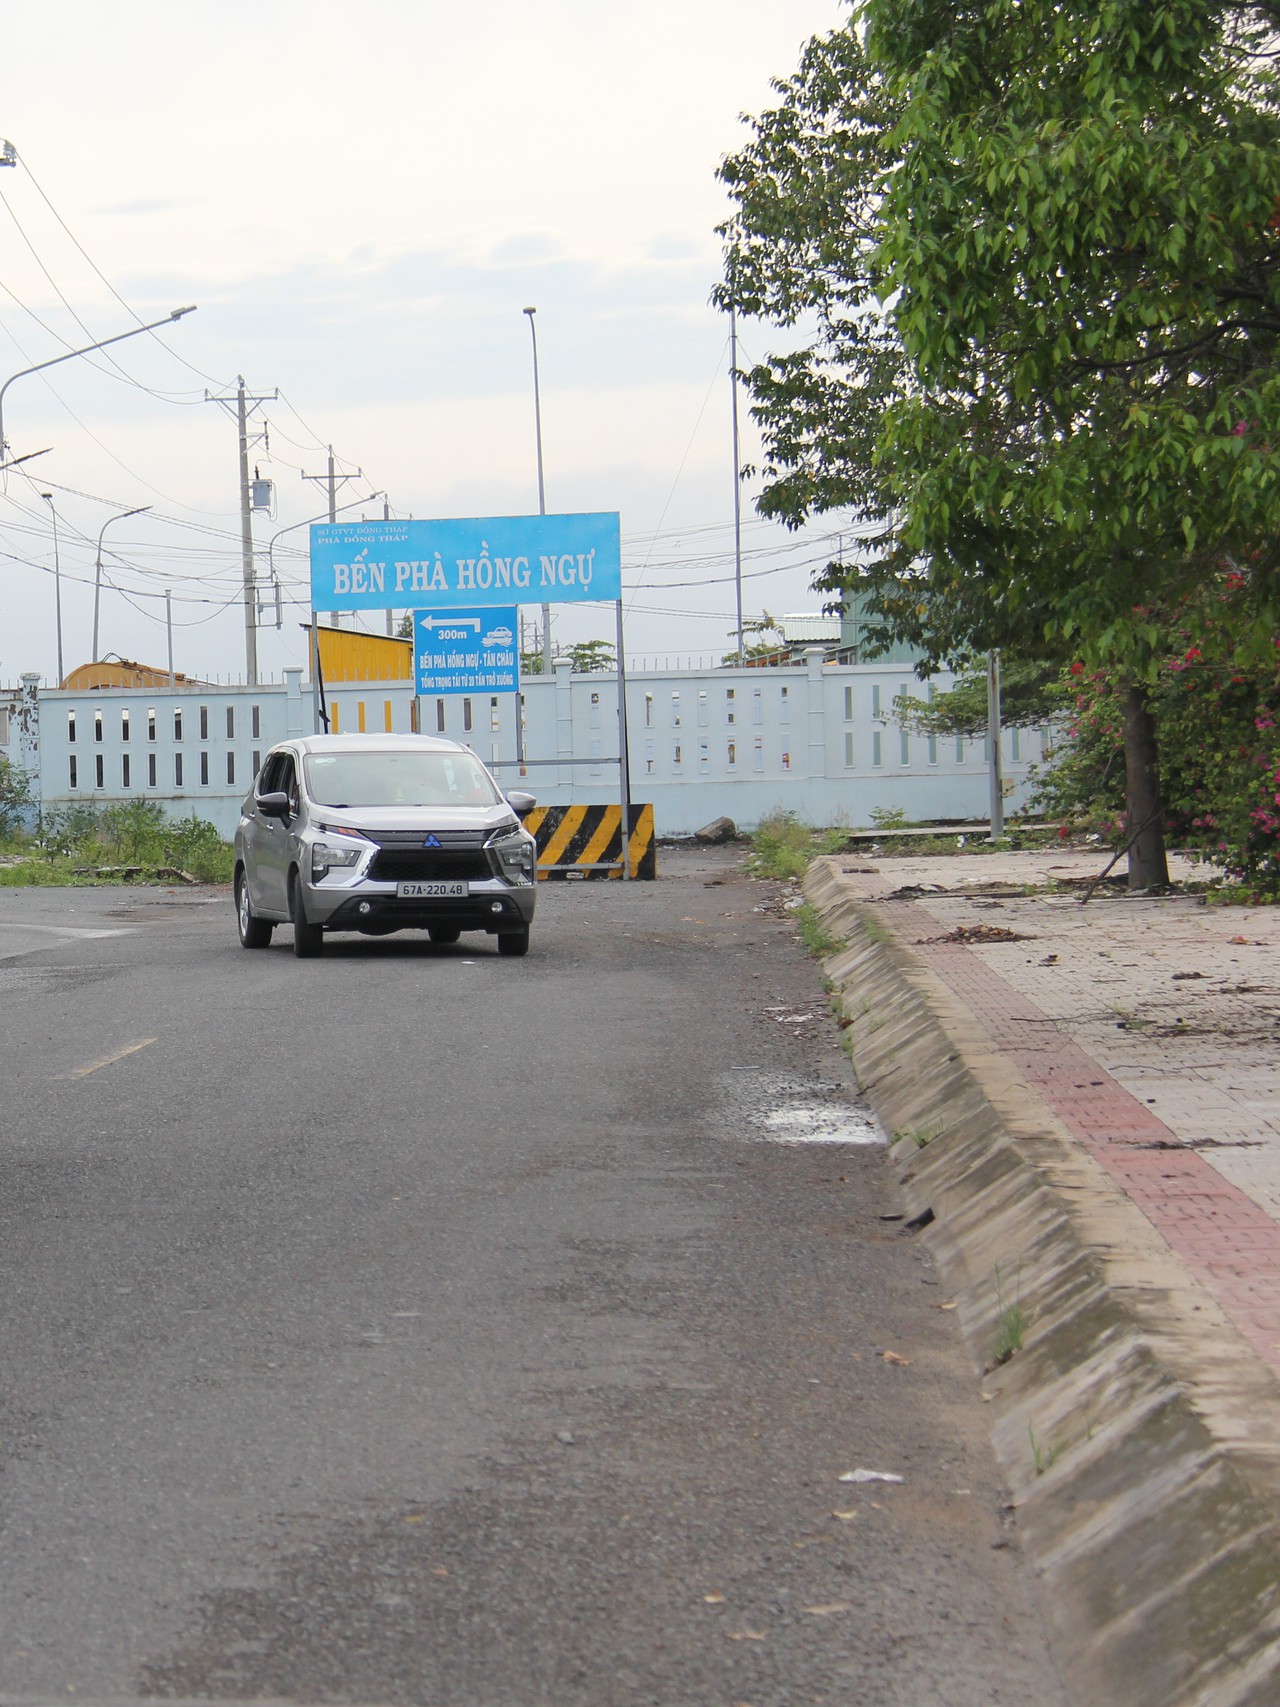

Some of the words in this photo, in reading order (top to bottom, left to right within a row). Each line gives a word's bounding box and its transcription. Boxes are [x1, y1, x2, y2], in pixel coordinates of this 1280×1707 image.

[333, 547, 386, 594] BẾN
[394, 551, 449, 591] PHÀ
[456, 540, 531, 590] HỒNG
[539, 547, 596, 592] NGỰ
[438, 629, 467, 640] 300m
[420, 650, 433, 669] BẾN
[433, 651, 447, 669] PHÀ
[496, 649, 514, 667] CHÂU
